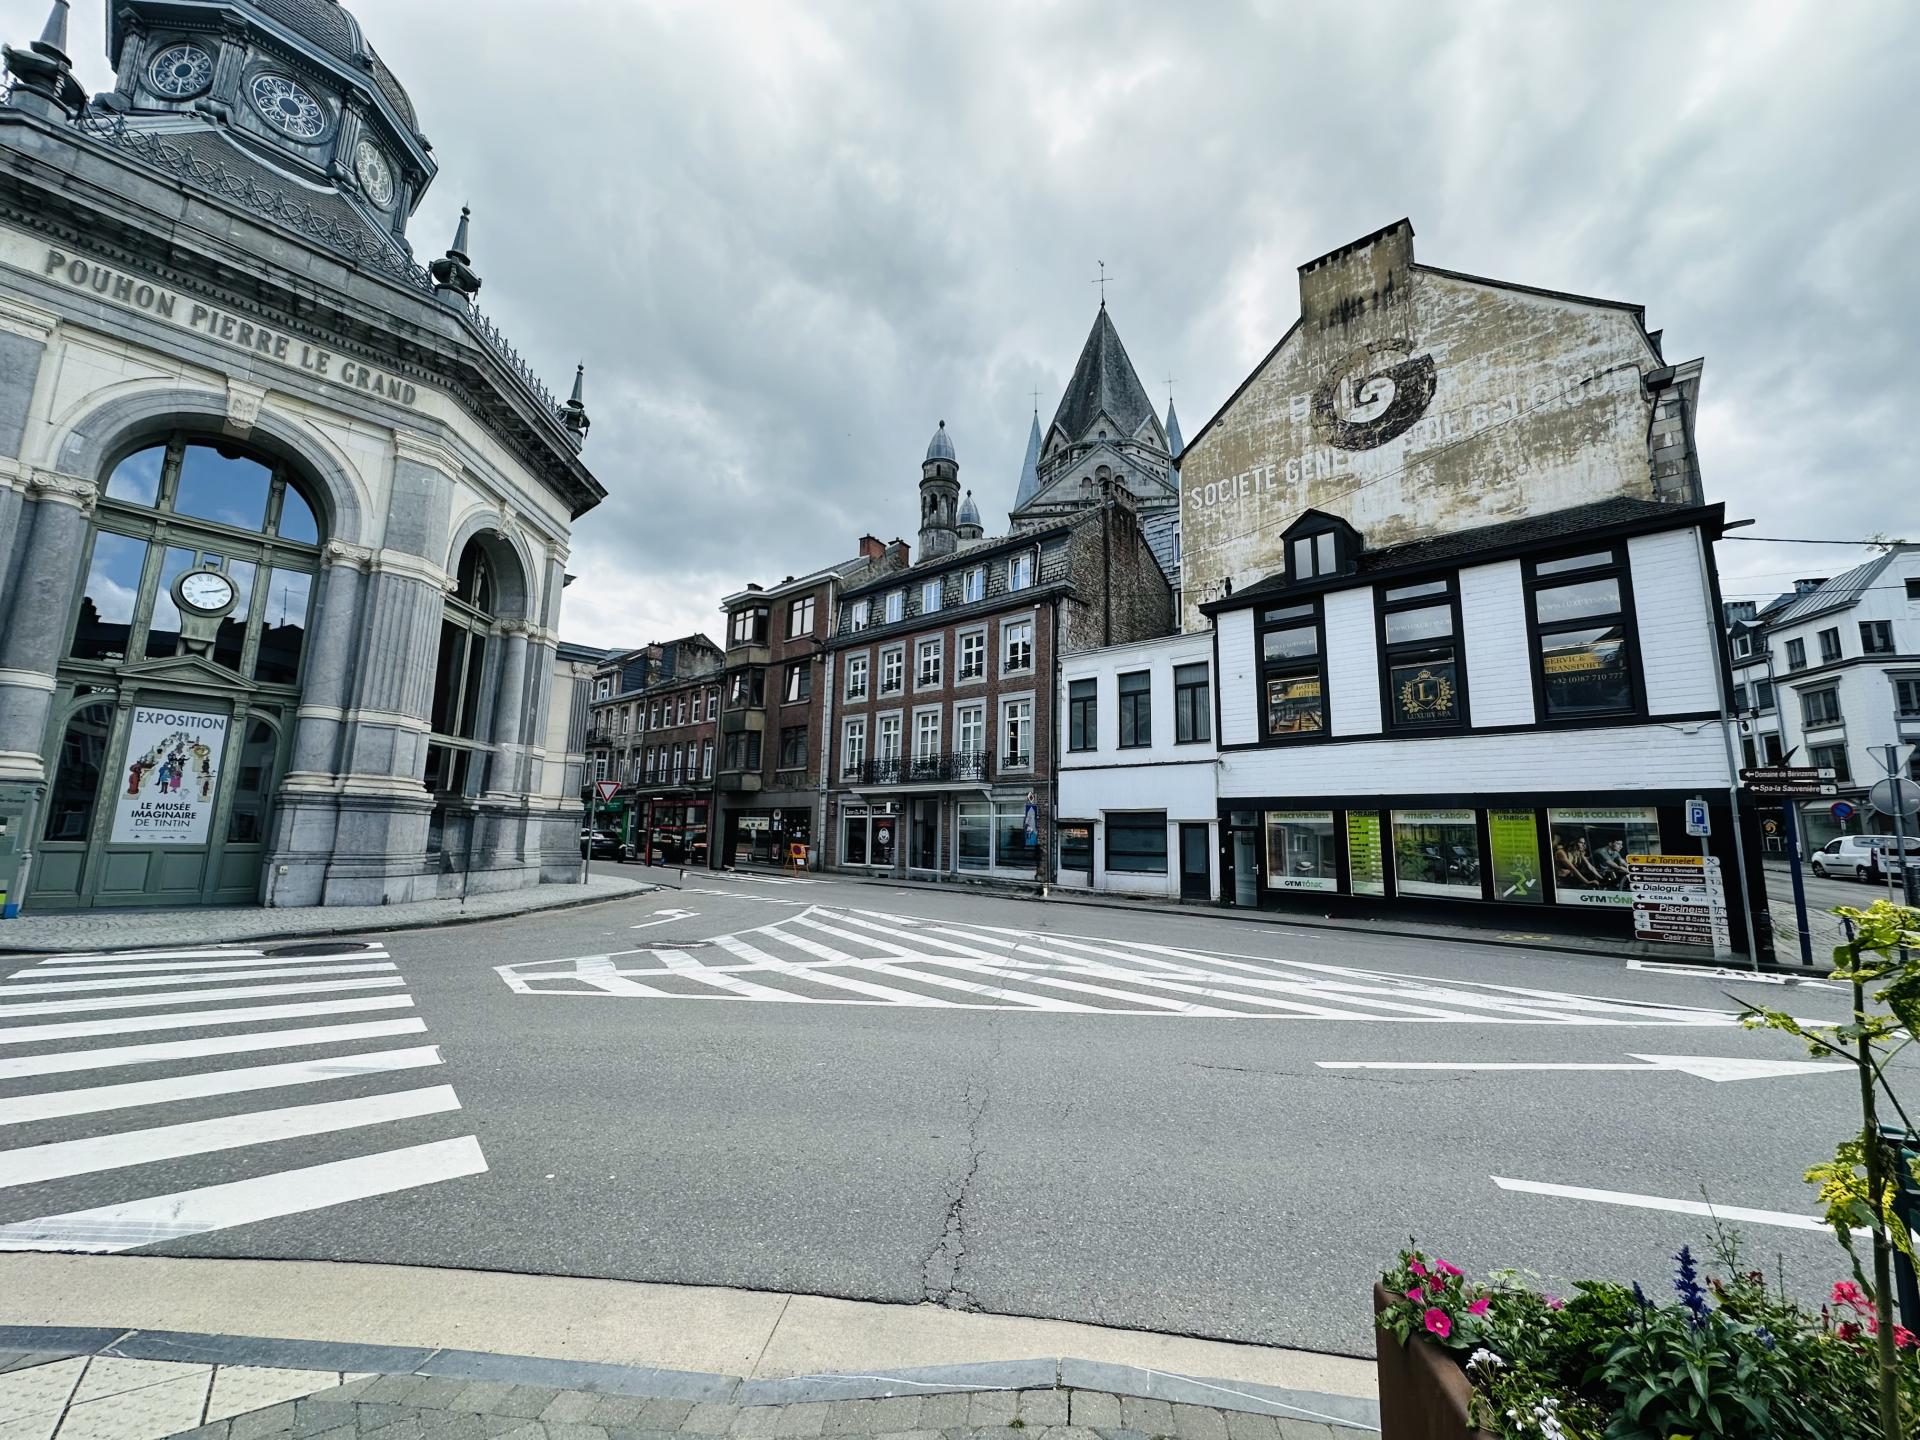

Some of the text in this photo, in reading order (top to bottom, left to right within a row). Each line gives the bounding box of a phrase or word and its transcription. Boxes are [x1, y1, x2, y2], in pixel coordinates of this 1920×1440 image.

[44, 248, 417, 406] POUHON PIERRE LE GRAND
[1190, 464, 1277, 511] SOCIETE
[1544, 655, 1585, 665] SERVICE
[1545, 661, 1601, 672] TRANSPORT
[1591, 673, 1607, 681] 710
[1417, 682, 1433, 700] L
[1407, 710, 1451, 720] LUXURY SPA
[136, 711, 225, 730] EXPOSITION
[1760, 784, 1820, 792] Spa-la Sauvenière
[141, 802, 191, 811] LE MUSÉE
[131, 810, 197, 819] IMAGINAIRE
[135, 818, 191, 827] DE TINTIN
[1646, 856, 1696, 865] Le Tonnelet
[1642, 884, 1685, 893] DialoguE
[1659, 904, 1696, 913] Piscine
